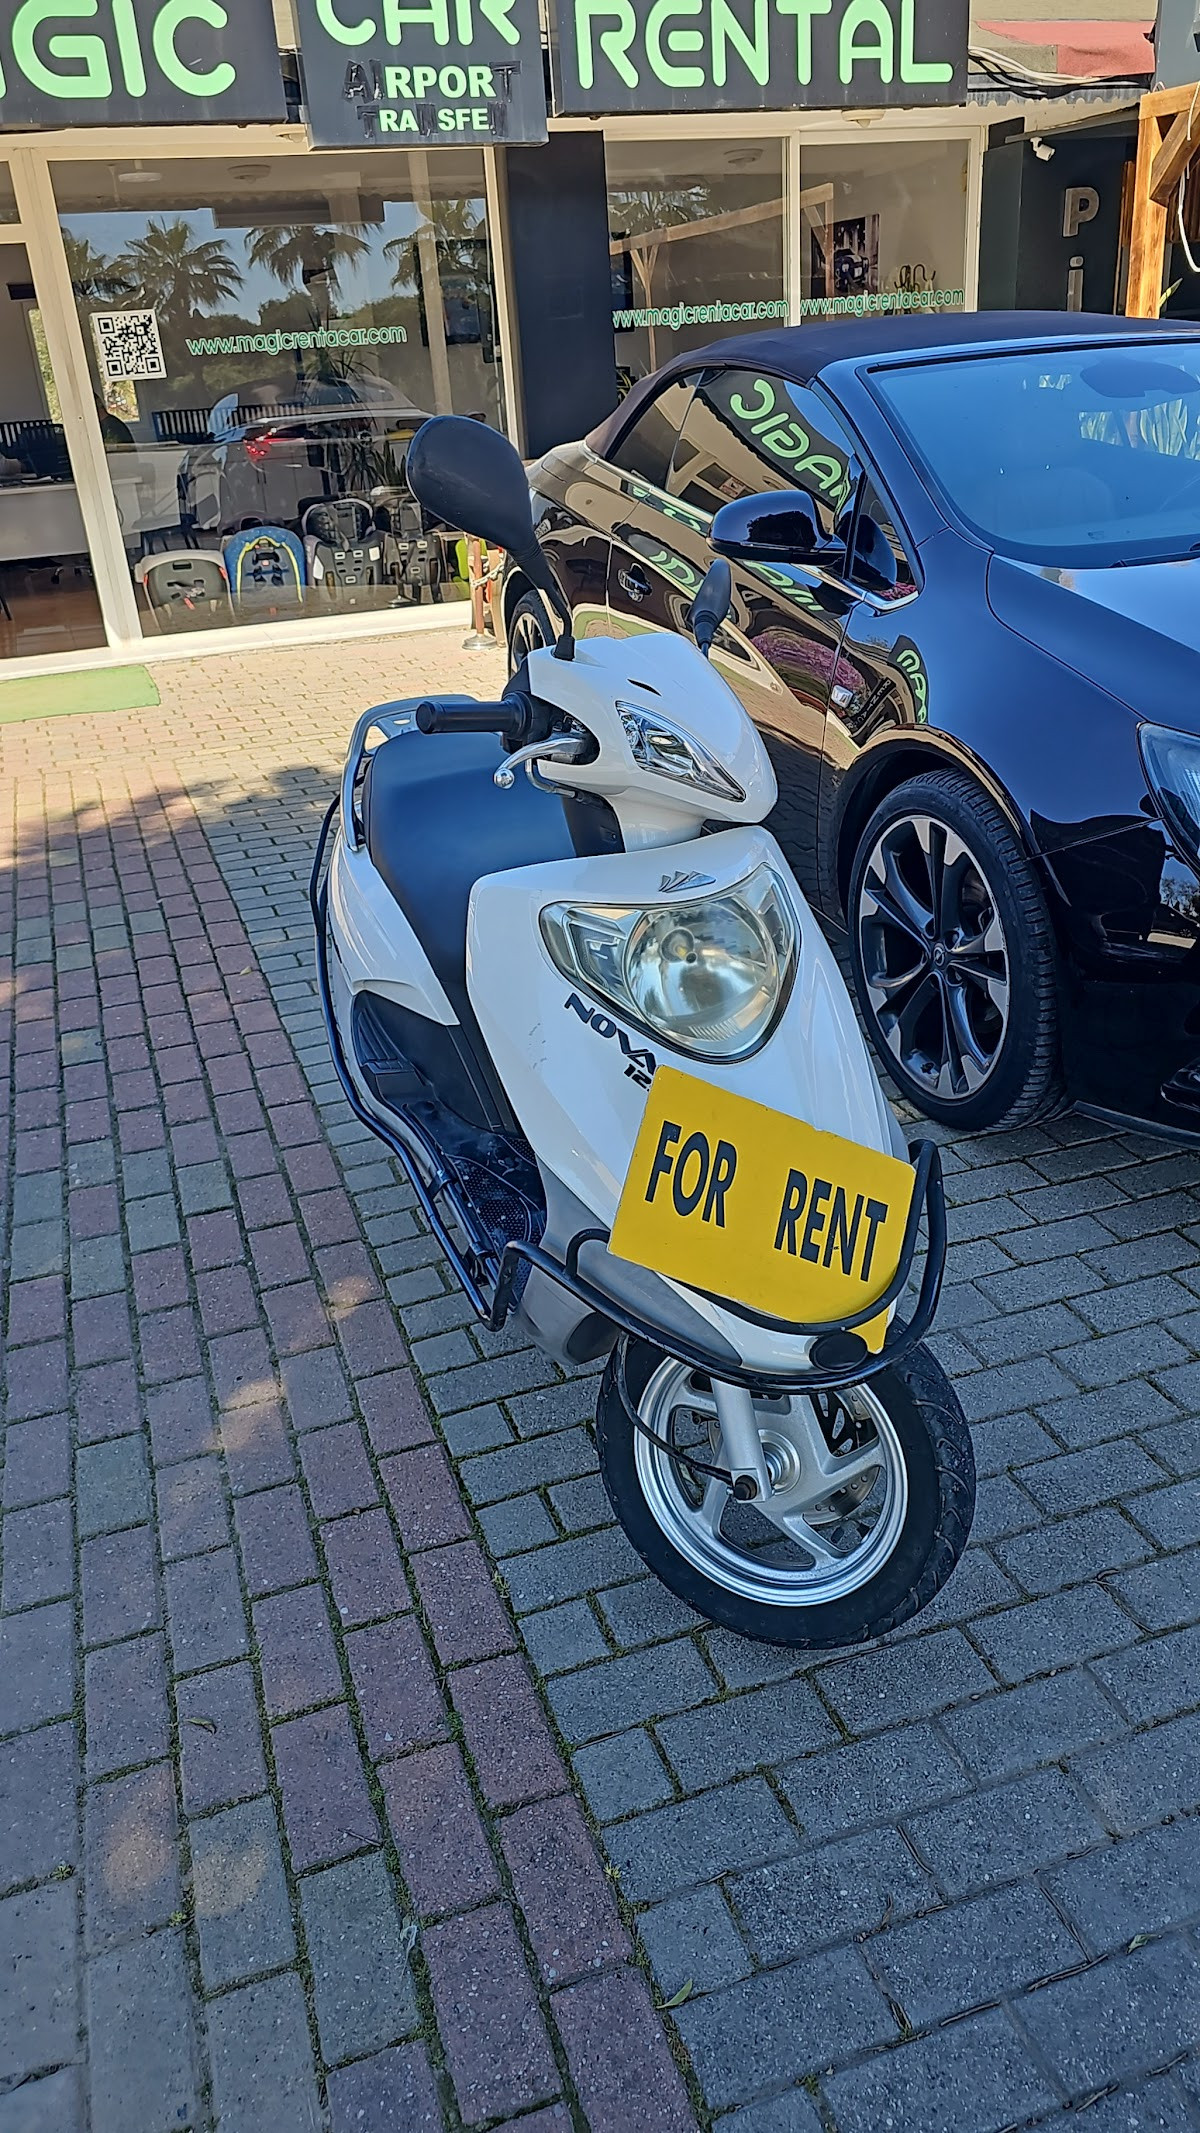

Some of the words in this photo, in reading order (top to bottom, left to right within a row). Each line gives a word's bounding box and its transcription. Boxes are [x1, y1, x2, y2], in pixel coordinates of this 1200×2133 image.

[0, 0, 237, 98] GIC
[574, 0, 955, 89] RENTAL
[185, 326, 408, 356] www.magicrentacar.com
[564, 992, 657, 1076] NOVA
[623, 1063, 652, 1092] 12
[644, 1120, 738, 1229] FOR
[773, 1167, 889, 1283] RENT
